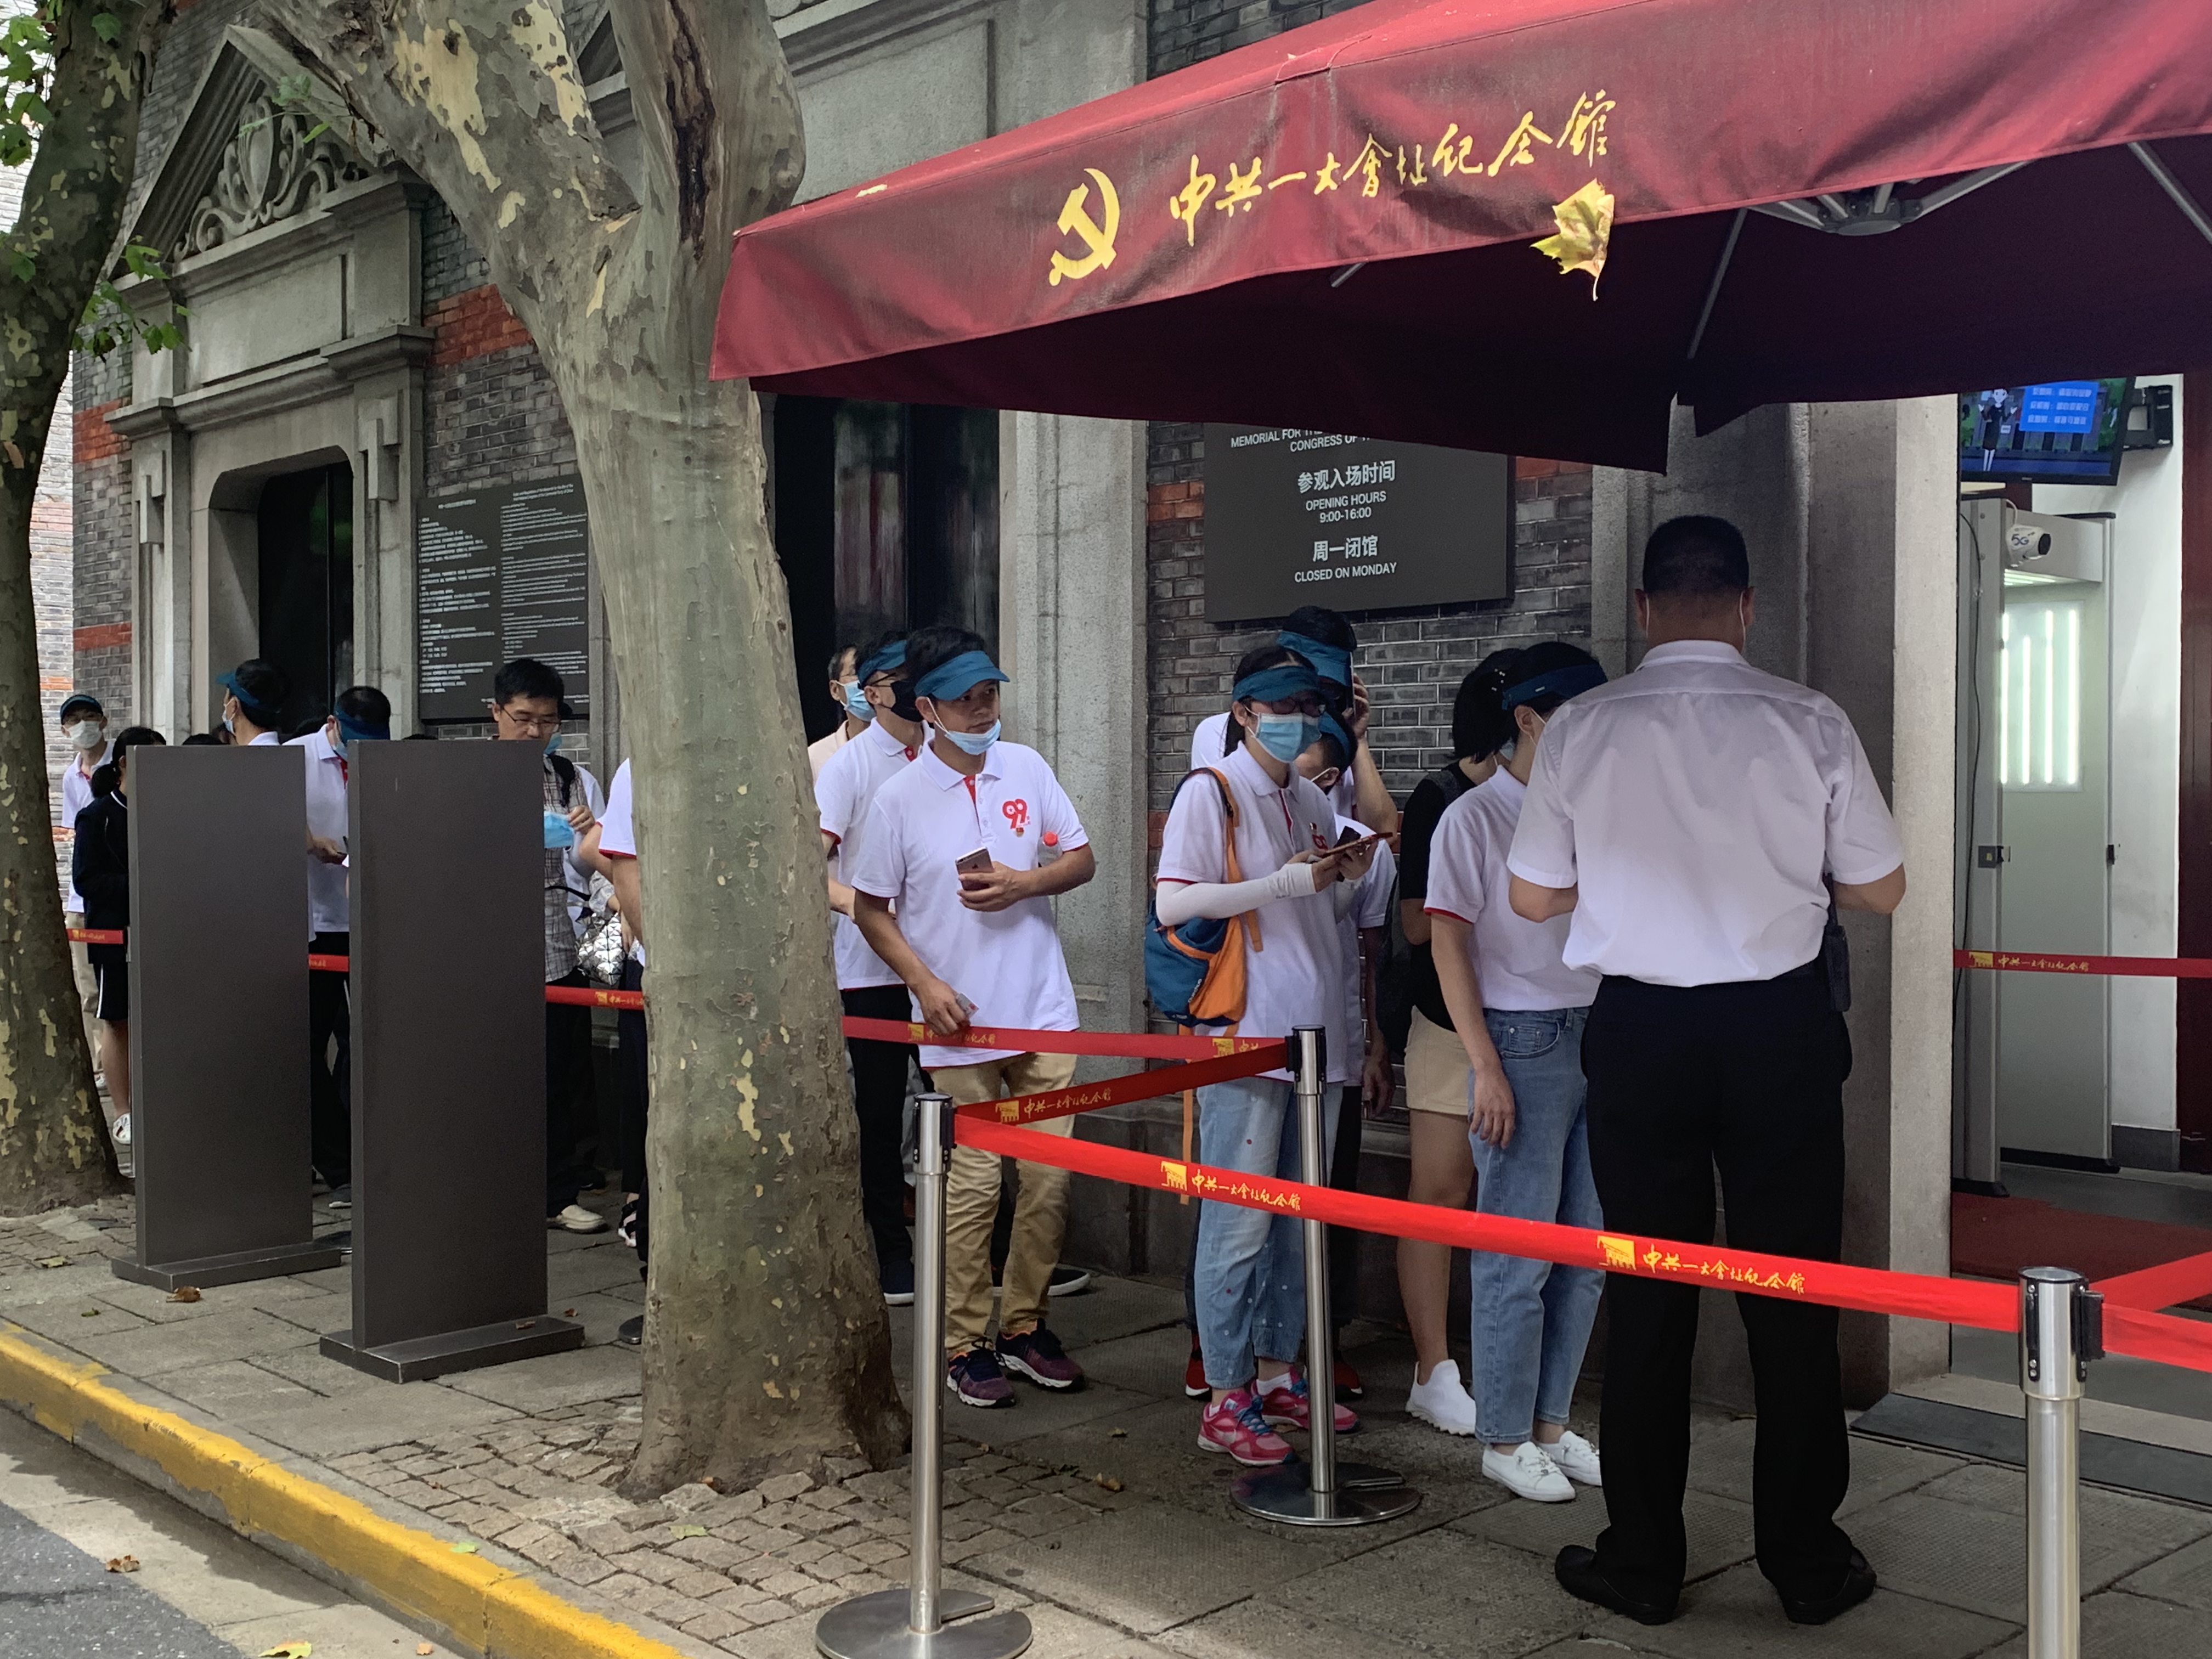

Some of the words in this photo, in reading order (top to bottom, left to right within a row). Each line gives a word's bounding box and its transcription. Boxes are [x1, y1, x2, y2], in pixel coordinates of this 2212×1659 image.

[1231, 431, 1280, 448] MEMORIAL
[1282, 428, 1301, 439] FOR
[1290, 434, 1342, 452] CONGRESS
[1298, 460, 1395, 493] 参观入场时间
[1306, 495, 1348, 511] OPENING
[1351, 491, 1386, 506] HOURS
[1320, 506, 1372, 523] 9:00-16:00
[1313, 535, 1378, 562] 周一闭馆
[2011, 533, 2029, 546] 5G
[1295, 569, 1333, 583] CLOSED
[1335, 567, 1350, 578] ON
[1352, 562, 1397, 577] MONDAY
